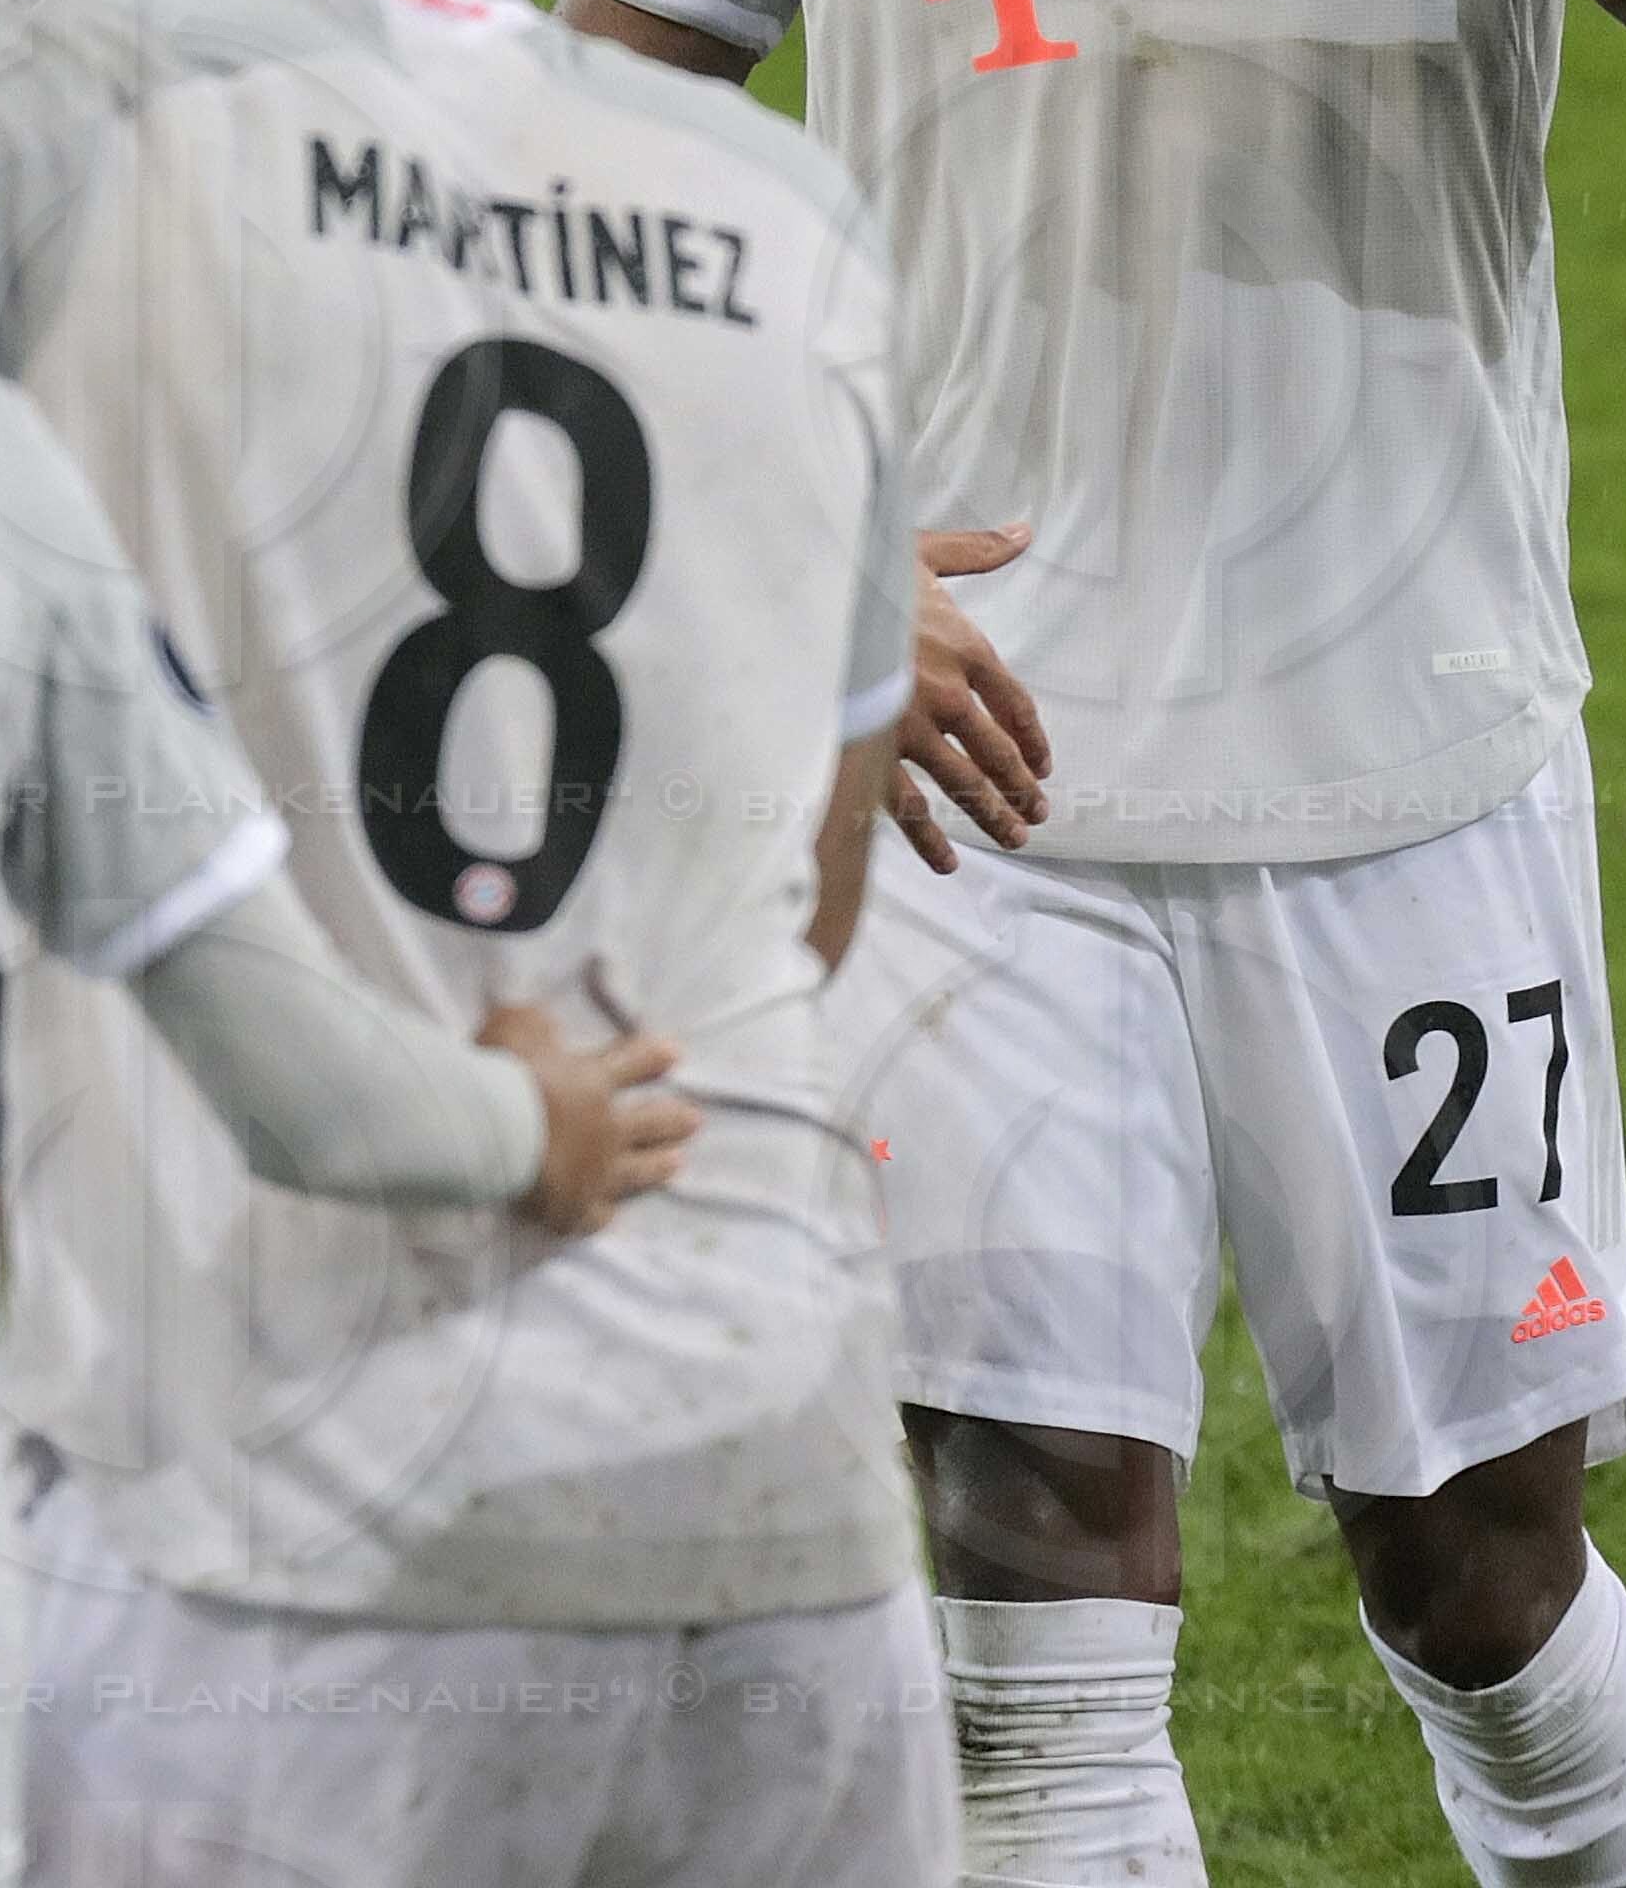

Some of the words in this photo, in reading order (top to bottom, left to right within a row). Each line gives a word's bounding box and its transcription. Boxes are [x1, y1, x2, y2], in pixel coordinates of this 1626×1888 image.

[358, 331, 655, 934] 8
[1383, 978, 1570, 1216] 27
[1511, 1297, 1607, 1344] adidas
